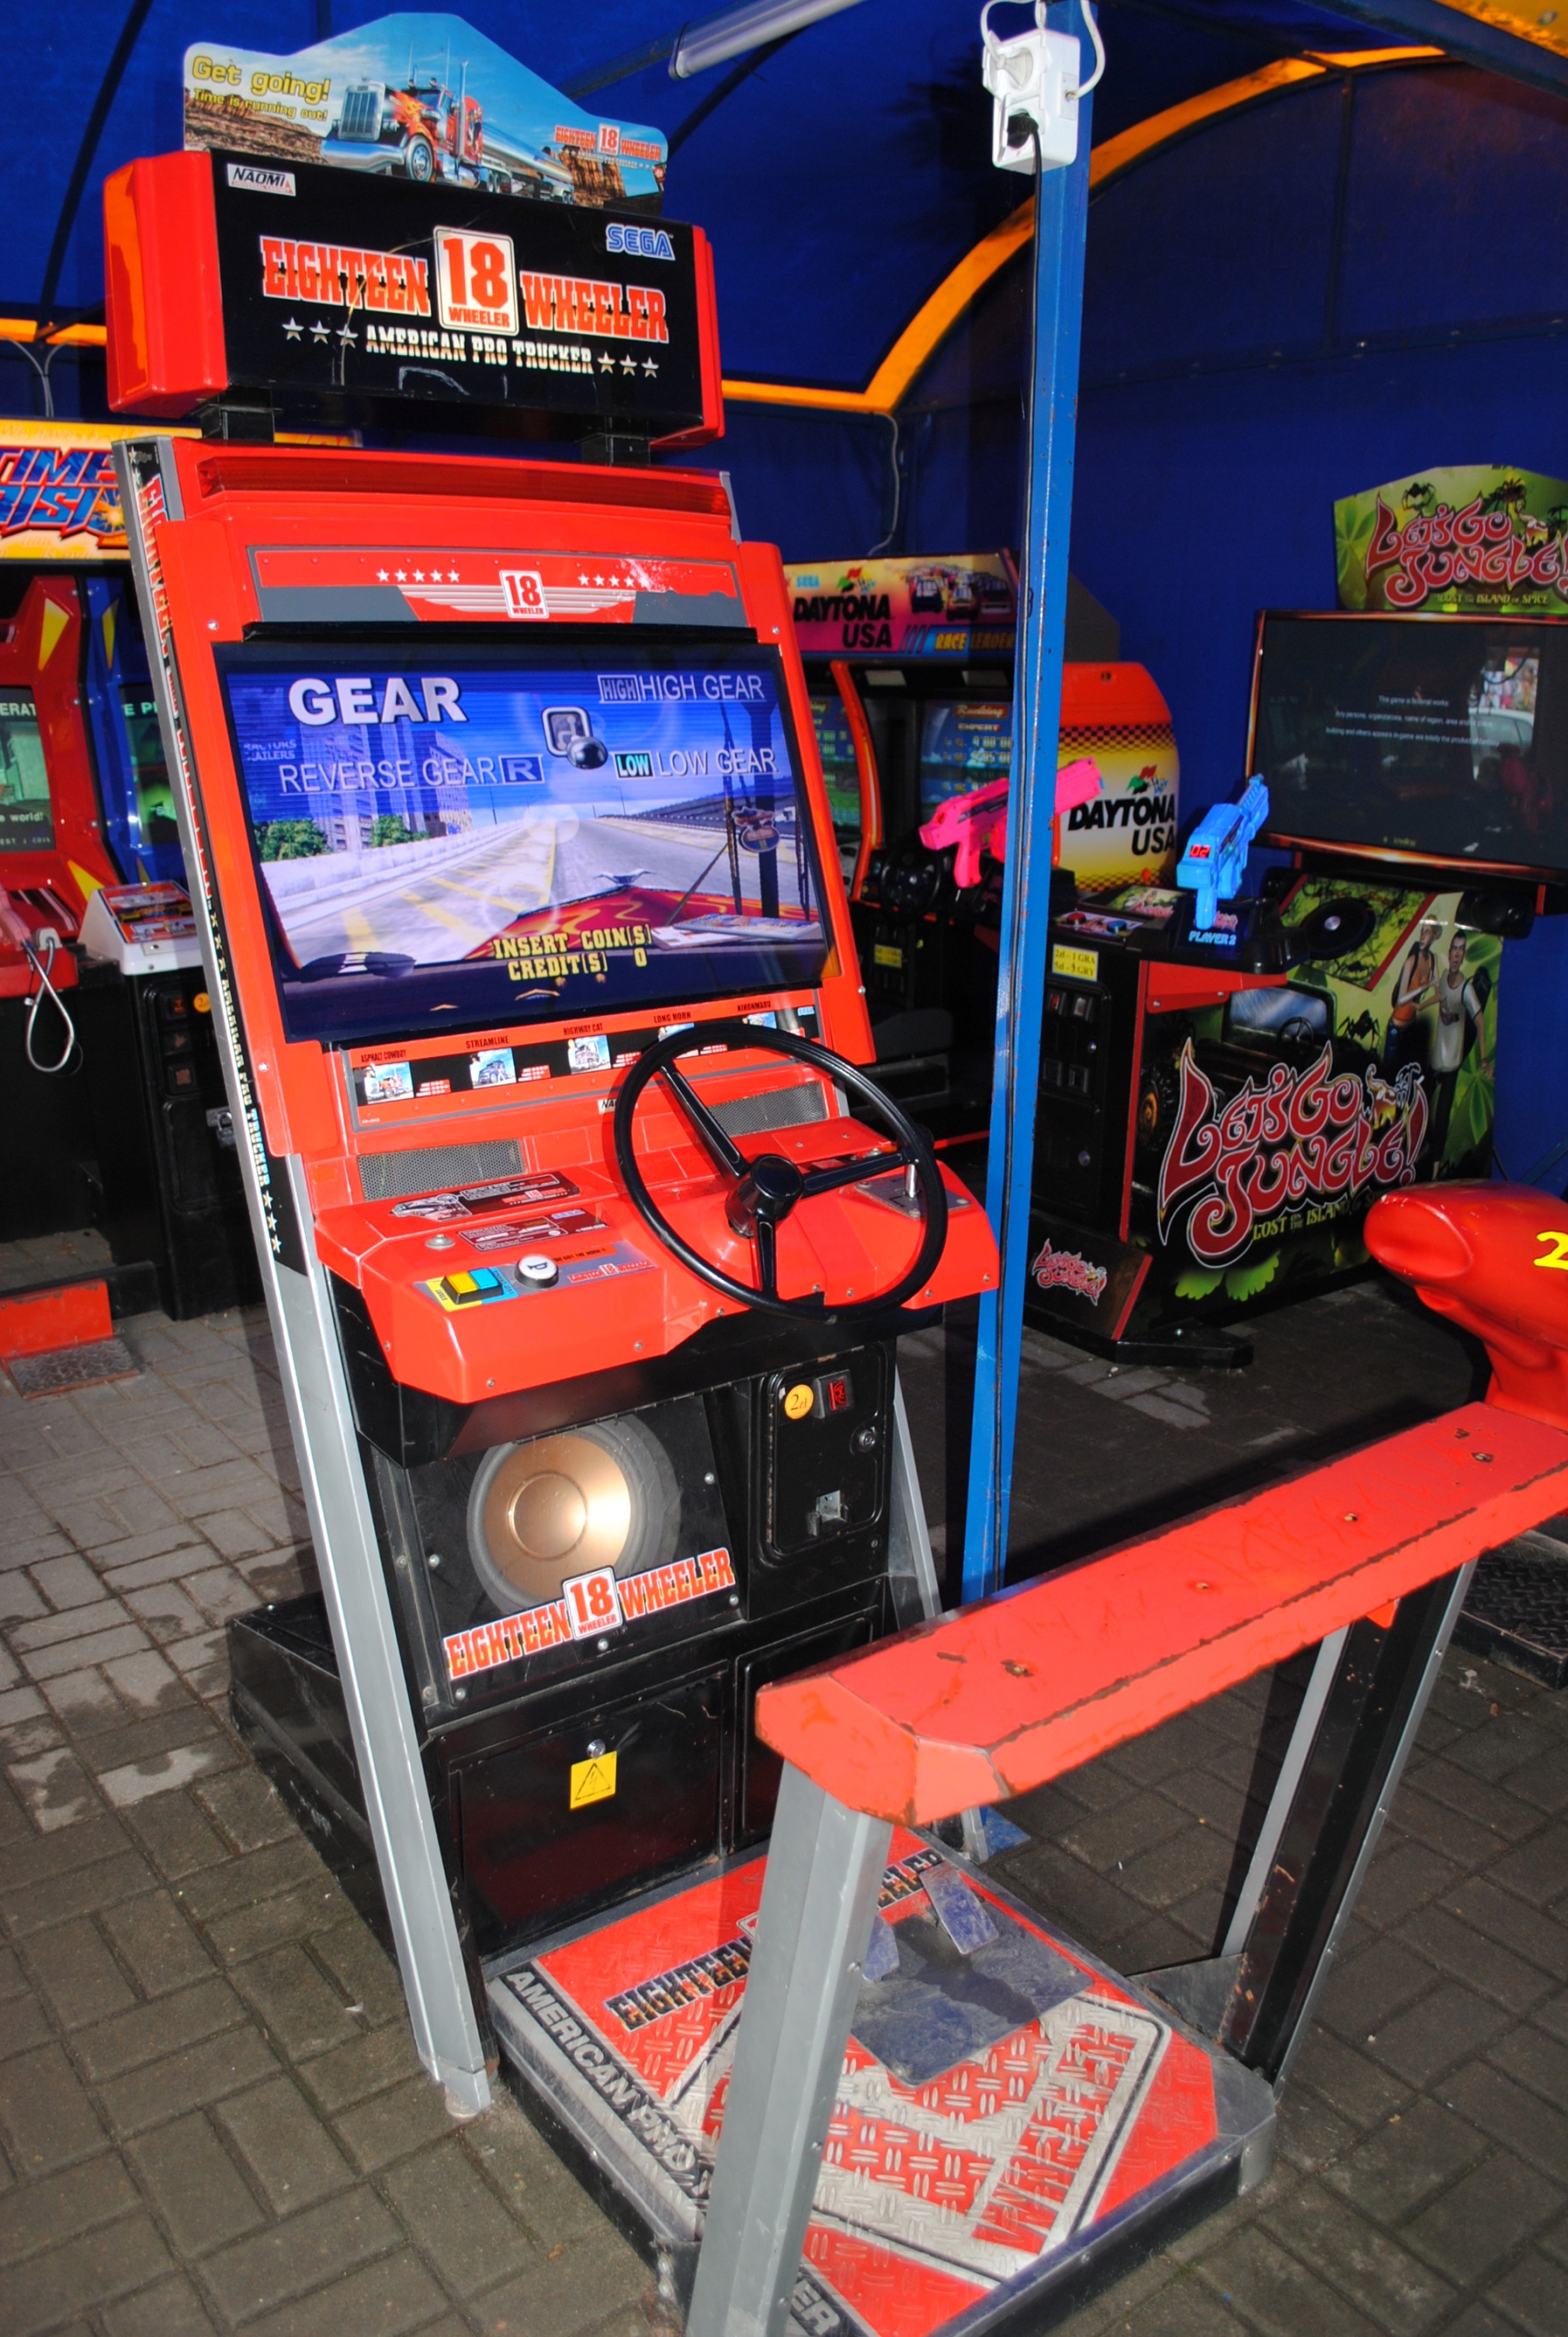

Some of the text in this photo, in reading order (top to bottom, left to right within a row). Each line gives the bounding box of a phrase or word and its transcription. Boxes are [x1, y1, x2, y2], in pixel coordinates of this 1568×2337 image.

[193, 56, 330, 105] Get going!
[194, 89, 329, 122] Time is running out!
[233, 167, 286, 188] NAOMI
[606, 223, 675, 260] SEGA
[260, 236, 432, 317] EIGHTEEN
[443, 238, 506, 309] 18
[448, 306, 510, 328] WHEELER
[519, 270, 669, 342] WHEELER
[366, 325, 594, 374] AMERICAN PRO TRUCKER
[505, 575, 541, 606] 18
[794, 594, 894, 622] DAYTONA
[841, 624, 893, 648] USA
[935, 633, 967, 650] RACE
[287, 677, 470, 726] GEAR
[602, 675, 766, 701] HIGH HIGH GEAR
[278, 756, 535, 793] REVERSE GEAR R
[617, 749, 779, 777] LOW LOW GEAR
[1068, 794, 1175, 831] DAYTONA
[1132, 825, 1175, 856] USA
[1189, 844, 1210, 858] 02
[493, 933, 569, 959] INSERT
[1188, 930, 1237, 946] PLAYER 2
[563, 1022, 604, 1036] HIGHWAY CAT
[653, 1011, 692, 1024] LONG HORN
[465, 1035, 509, 1049] STREAMLINE
[246, 1106, 271, 1188] TRUCKER
[1253, 1217, 1287, 1241] LOST
[616, 1547, 736, 1621] WHEELER
[570, 1576, 615, 1624] 18
[578, 1613, 618, 1634] WHEELER
[444, 1599, 572, 1680] EIGHTEEN
[601, 1933, 752, 2033] EIGHTEE
[507, 1970, 697, 2172] AMERICAN PRO
